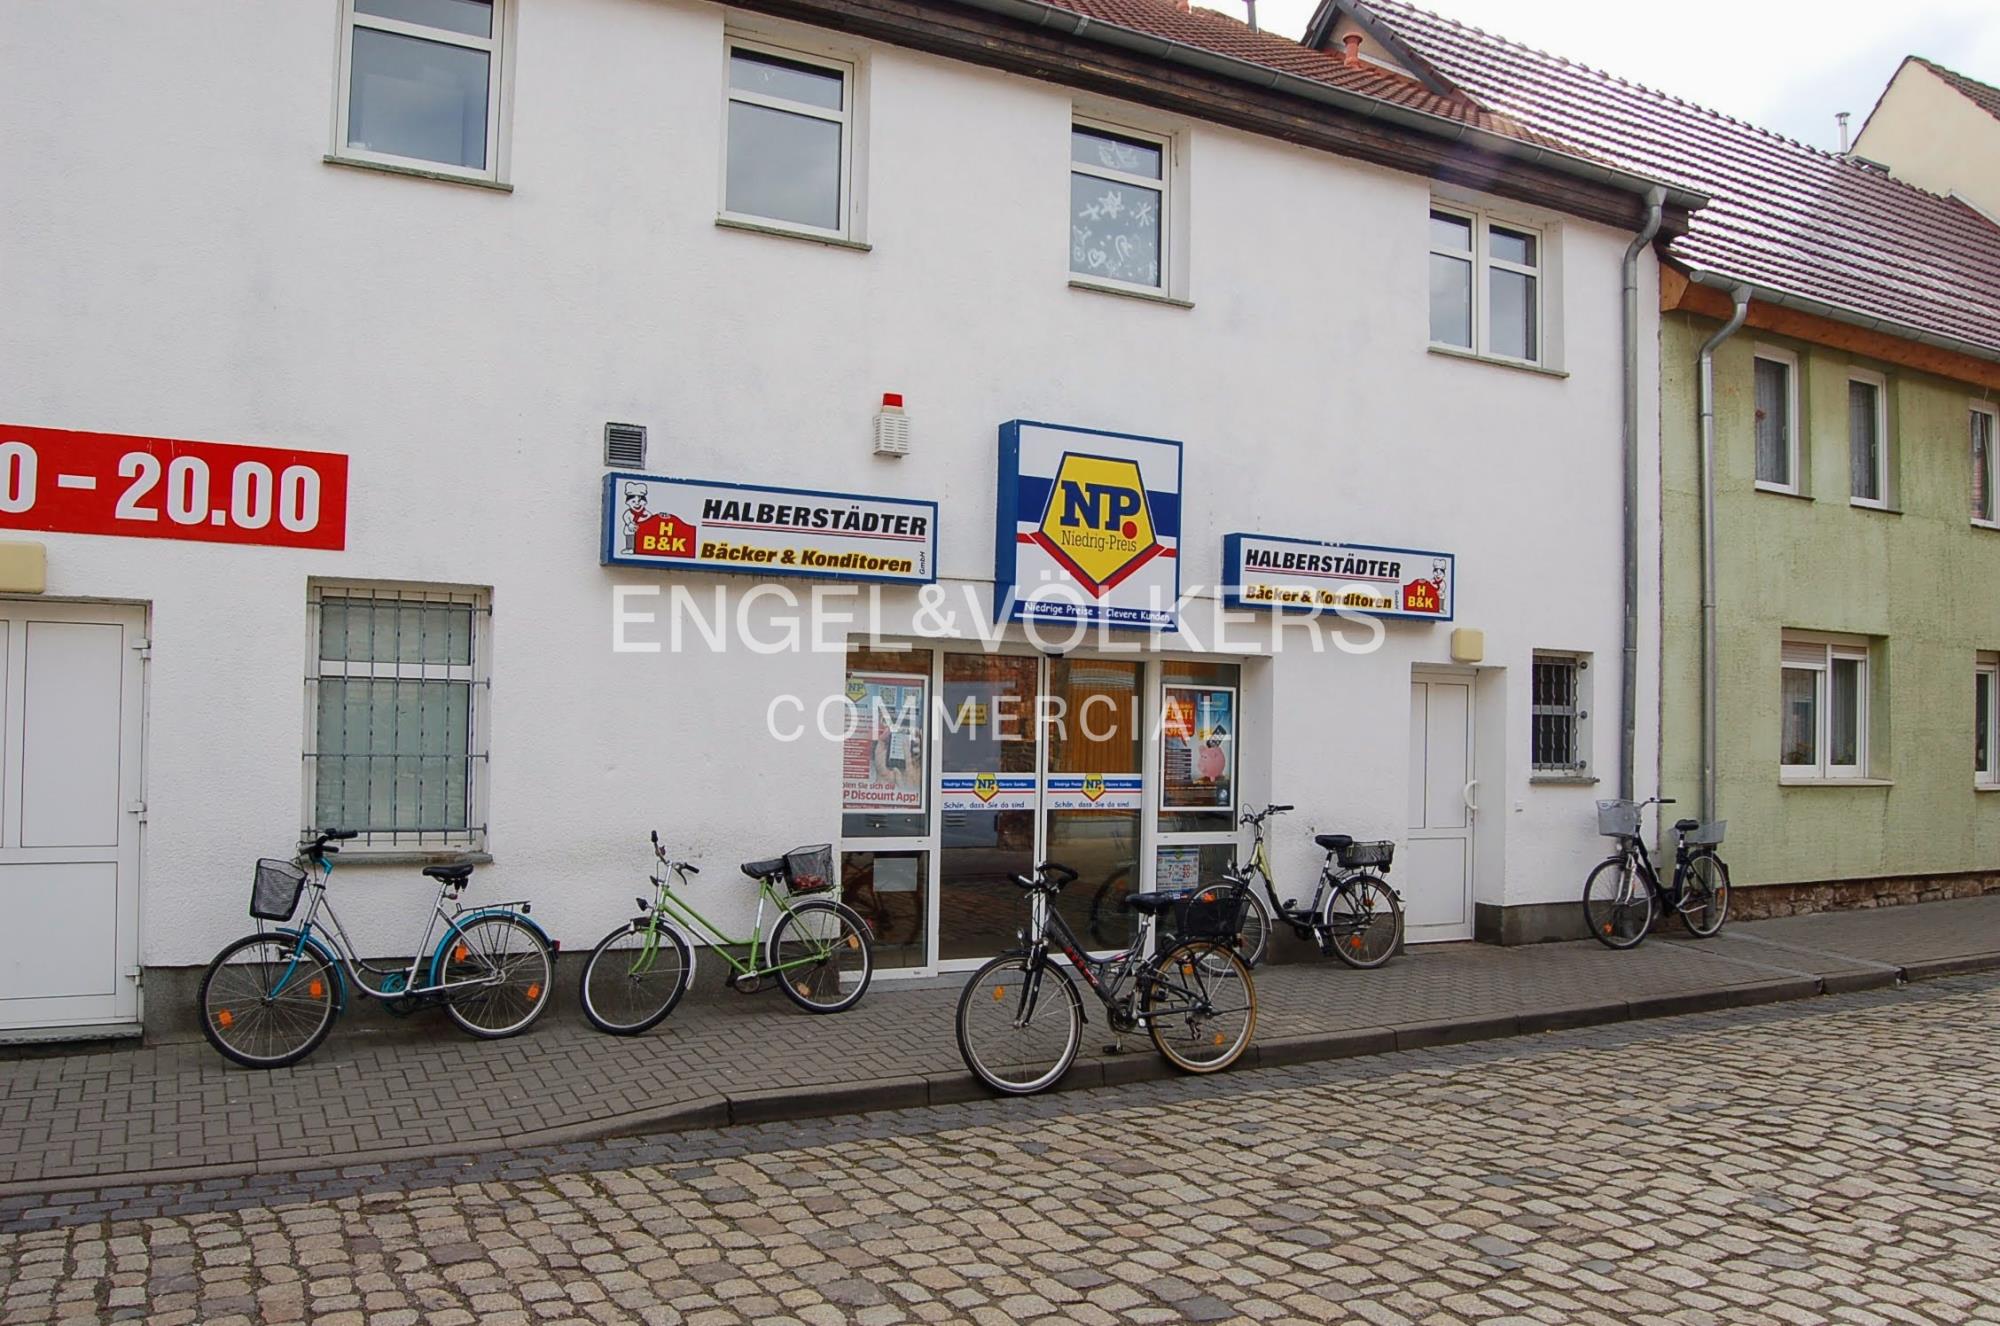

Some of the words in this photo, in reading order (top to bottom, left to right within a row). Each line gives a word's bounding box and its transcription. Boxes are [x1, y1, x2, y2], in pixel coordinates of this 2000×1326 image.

[115, 451, 321, 533] 20.00
[702, 498, 927, 536] HALBERSTÄDTER
[659, 521, 674, 537] H
[643, 535, 687, 553] B&K
[1060, 530, 1138, 552] Niedrig-Preis
[701, 542, 778, 563] Bäcker
[780, 549, 796, 565] &
[801, 550, 912, 573] Konditoren
[1245, 549, 1401, 578] HALBERSTÄDTER
[1246, 585, 1298, 603] Bäcker
[1300, 590, 1312, 604] &
[1315, 590, 1392, 609] Konditoren
[1416, 585, 1426, 596] H
[1024, 601, 1064, 616] Niedrige
[1066, 604, 1094, 616] Preise
[1106, 608, 1138, 620] Clevere
[1141, 612, 1170, 622] Kunden
[1407, 595, 1434, 609] B&K
[851, 790, 895, 801] Discount
[896, 792, 919, 803] App!
